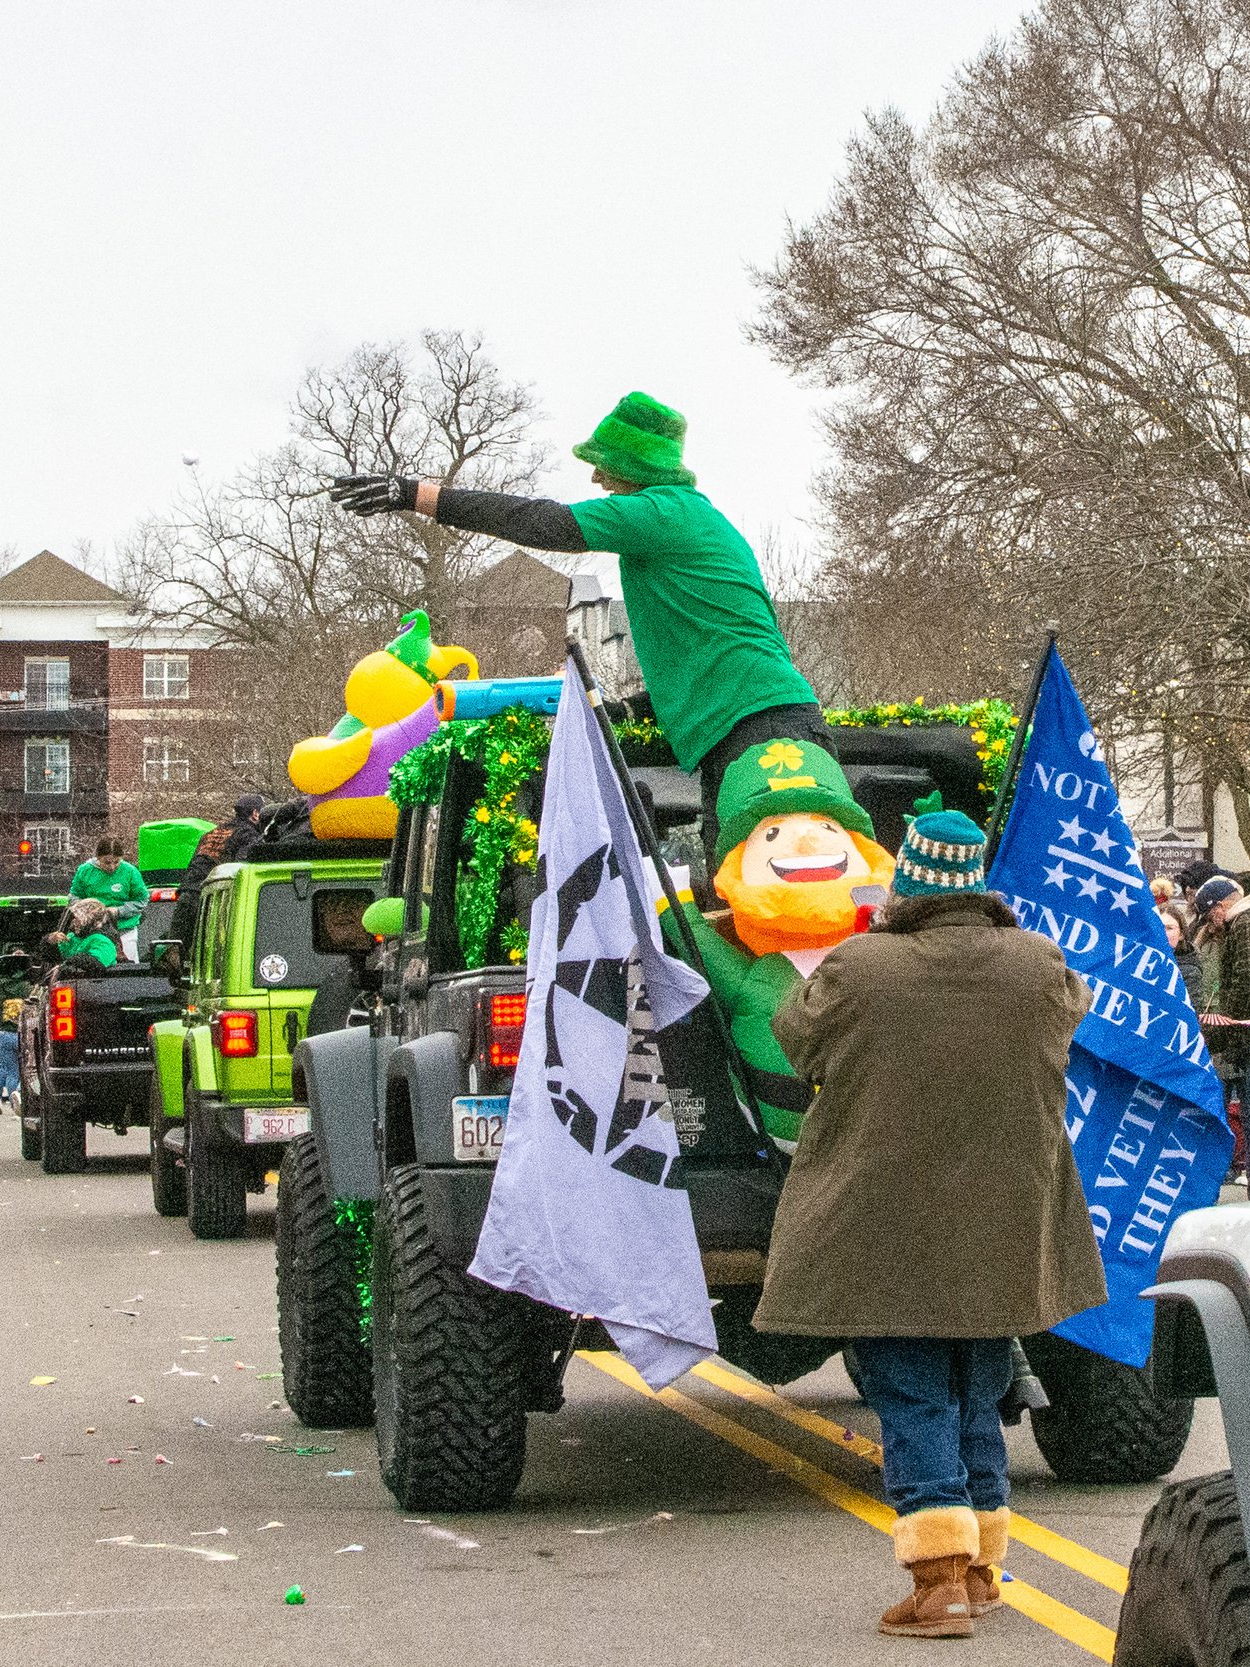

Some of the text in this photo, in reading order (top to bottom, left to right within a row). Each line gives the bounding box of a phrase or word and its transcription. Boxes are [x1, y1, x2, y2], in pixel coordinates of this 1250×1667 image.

[1029, 763, 1108, 811] NOT
[1159, 861, 1186, 869] Public
[263, 1119, 283, 1136] 962
[461, 1115, 503, 1148] 602
[1119, 1131, 1198, 1258] THEY
